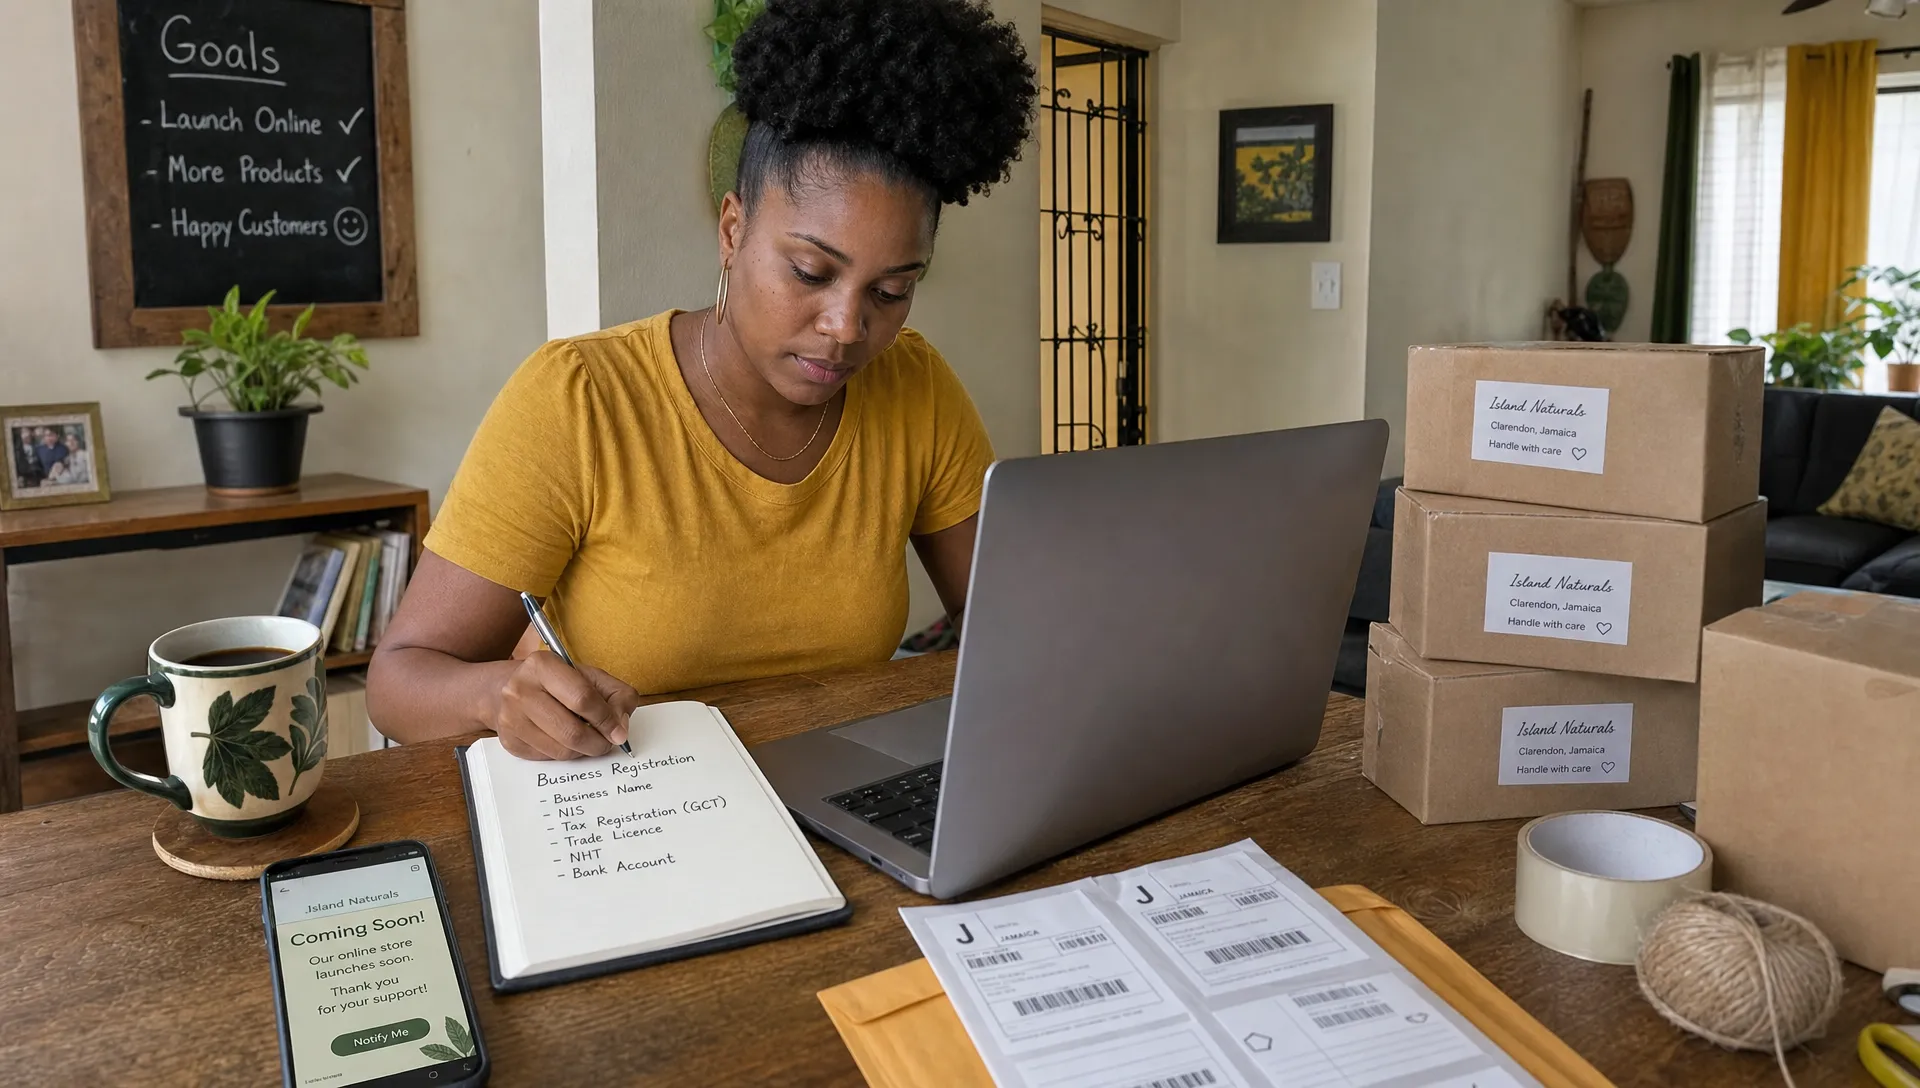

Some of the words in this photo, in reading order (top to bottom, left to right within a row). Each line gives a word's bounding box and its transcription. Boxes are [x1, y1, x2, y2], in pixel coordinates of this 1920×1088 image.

[160, 14, 280, 74] Goals
[160, 100, 243, 132] Launch
[255, 106, 322, 135] Online
[168, 155, 224, 184] More
[240, 155, 324, 184] Products
[171, 208, 232, 248] Happy
[238, 208, 328, 236] Customers
[1489, 396, 1528, 412] Island
[1530, 399, 1586, 417] Naturals
[1490, 421, 1538, 435] Clarendon,
[1540, 426, 1576, 438] Jamaica
[1489, 439, 1519, 450] Handle
[1522, 443, 1540, 453] with
[1542, 448, 1562, 456] care
[1510, 574, 1552, 588] Island
[1555, 575, 1614, 593] Naturals
[1510, 598, 1560, 610] Clarendon,
[1562, 602, 1602, 612] Jamaica
[1508, 617, 1540, 627] Handle
[1543, 620, 1562, 628] with
[1565, 622, 1586, 630] care
[1517, 722, 1558, 736] Island
[1560, 720, 1615, 735] Naturals
[1518, 746, 1566, 756] Clarendon,
[1568, 746, 1604, 754] Jamaica
[538, 769, 602, 786] Business
[612, 754, 695, 778] Registration
[1516, 766, 1548, 774] Handle
[1550, 765, 1569, 774] with
[554, 789, 608, 804] Business
[617, 782, 652, 794] Name
[558, 806, 584, 818] NIS
[562, 821, 586, 832] Tax
[597, 808, 676, 828] Registration
[683, 796, 727, 814] (GCT)
[565, 834, 603, 848] Trade
[613, 826, 663, 840] Licence
[570, 849, 602, 863] NHT
[573, 865, 608, 879] Bank
[616, 853, 676, 872] Account
[349, 890, 399, 906] Naturals
[1136, 885, 1154, 904] J
[1179, 888, 1214, 900] JAMAICA
[290, 924, 368, 946] Coming
[372, 910, 426, 932] Soon!
[956, 923, 974, 944] J
[1000, 930, 1040, 942] JAMAICA
[309, 954, 334, 966] Our
[338, 946, 376, 960] online
[380, 938, 412, 952] store
[316, 960, 375, 980] launches
[380, 955, 414, 966] soon.
[331, 981, 372, 997] Thank
[375, 976, 399, 990] you
[318, 1004, 336, 1015] for
[340, 997, 370, 1013] your
[374, 984, 428, 1003] support!
[354, 1032, 388, 1047] Notify
[392, 1028, 408, 1042] Me
